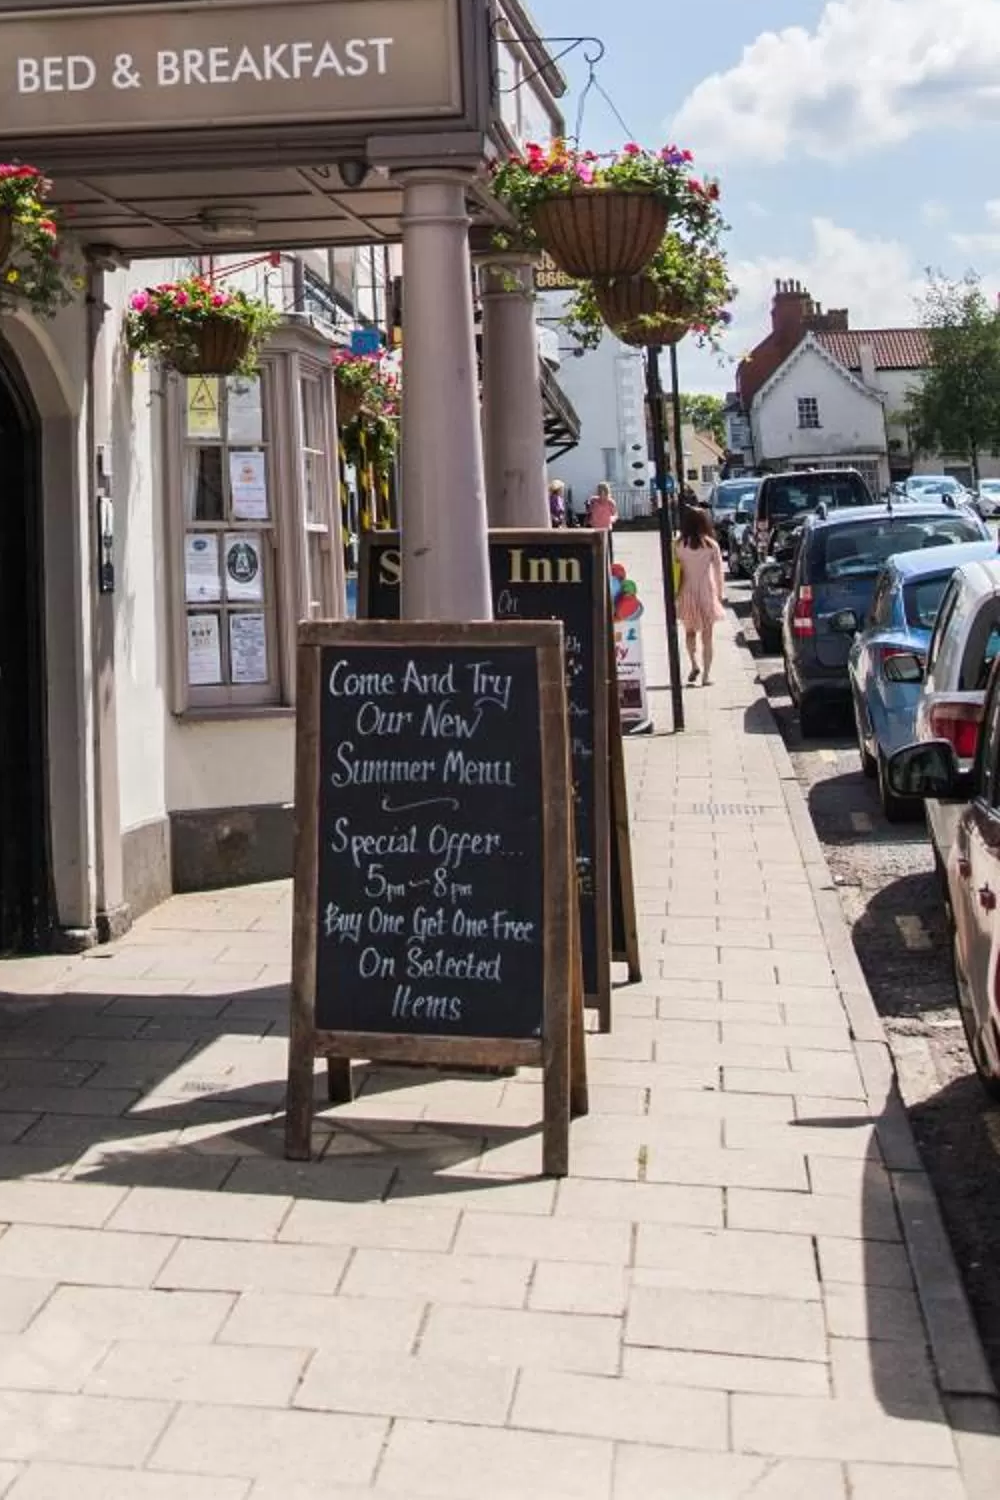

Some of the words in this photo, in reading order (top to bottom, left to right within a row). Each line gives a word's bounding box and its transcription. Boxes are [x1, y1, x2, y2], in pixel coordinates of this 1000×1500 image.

[17, 55, 97, 93] BED
[111, 53, 142, 90] &
[156, 37, 394, 87] BREAKFAST
[508, 549, 582, 584] Inn
[329, 659, 394, 697] Come
[401, 659, 458, 693] And
[465, 660, 513, 711] Try
[356, 701, 413, 735] Our
[420, 701, 483, 739] New
[331, 741, 436, 788] Summer
[443, 750, 516, 786] Menu
[331, 816, 418, 869] Special
[324, 901, 363, 943] Buy
[368, 906, 405, 935] One
[407, 905, 447, 945] Get
[452, 908, 489, 938] One
[491, 910, 535, 943] Free
[359, 947, 396, 979] On
[406, 946, 503, 982] Selected
[391, 984, 463, 1021] Items
